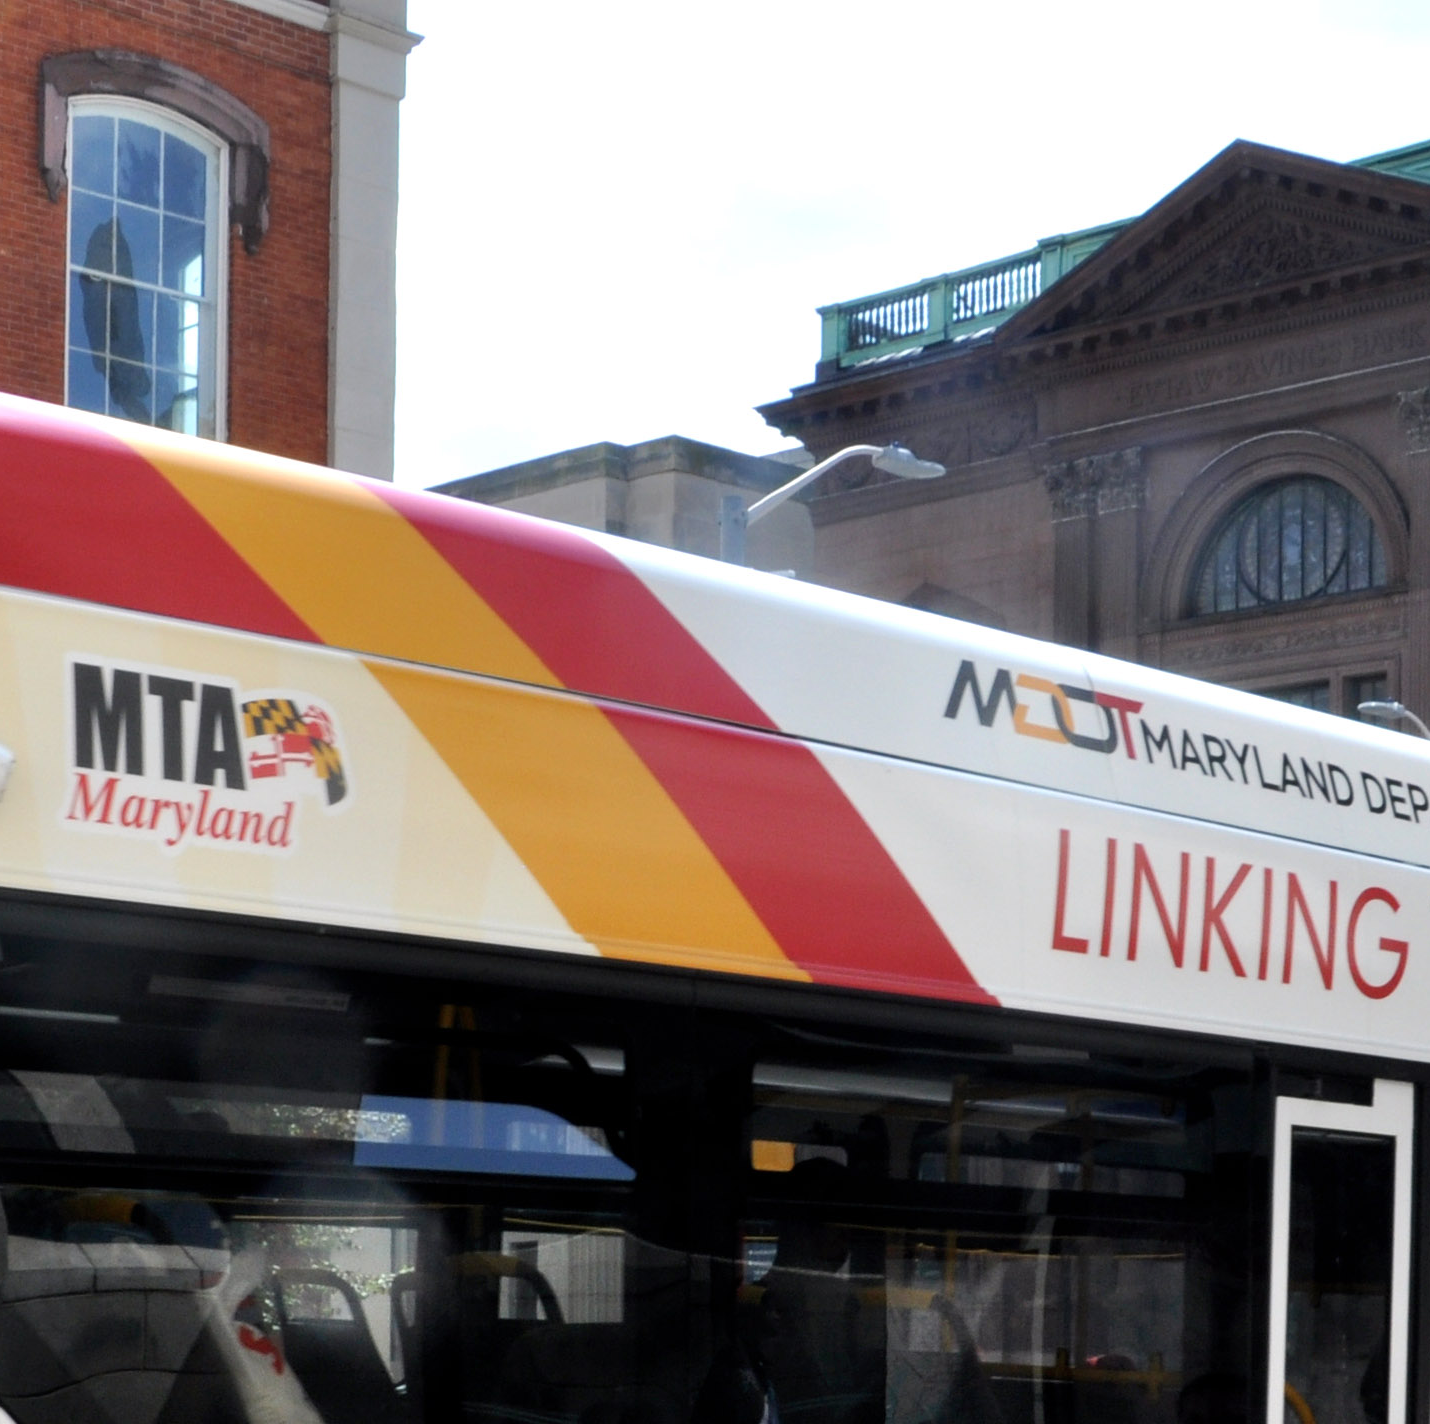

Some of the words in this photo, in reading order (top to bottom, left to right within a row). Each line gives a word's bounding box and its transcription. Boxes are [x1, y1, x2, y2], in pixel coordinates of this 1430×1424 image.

[1351, 321, 1429, 363] BANK
[72, 662, 247, 791] MTA
[1140, 719, 1354, 807] MARYLAND
[66, 773, 294, 847] Maryland
[1052, 828, 1410, 1000] LINKING
